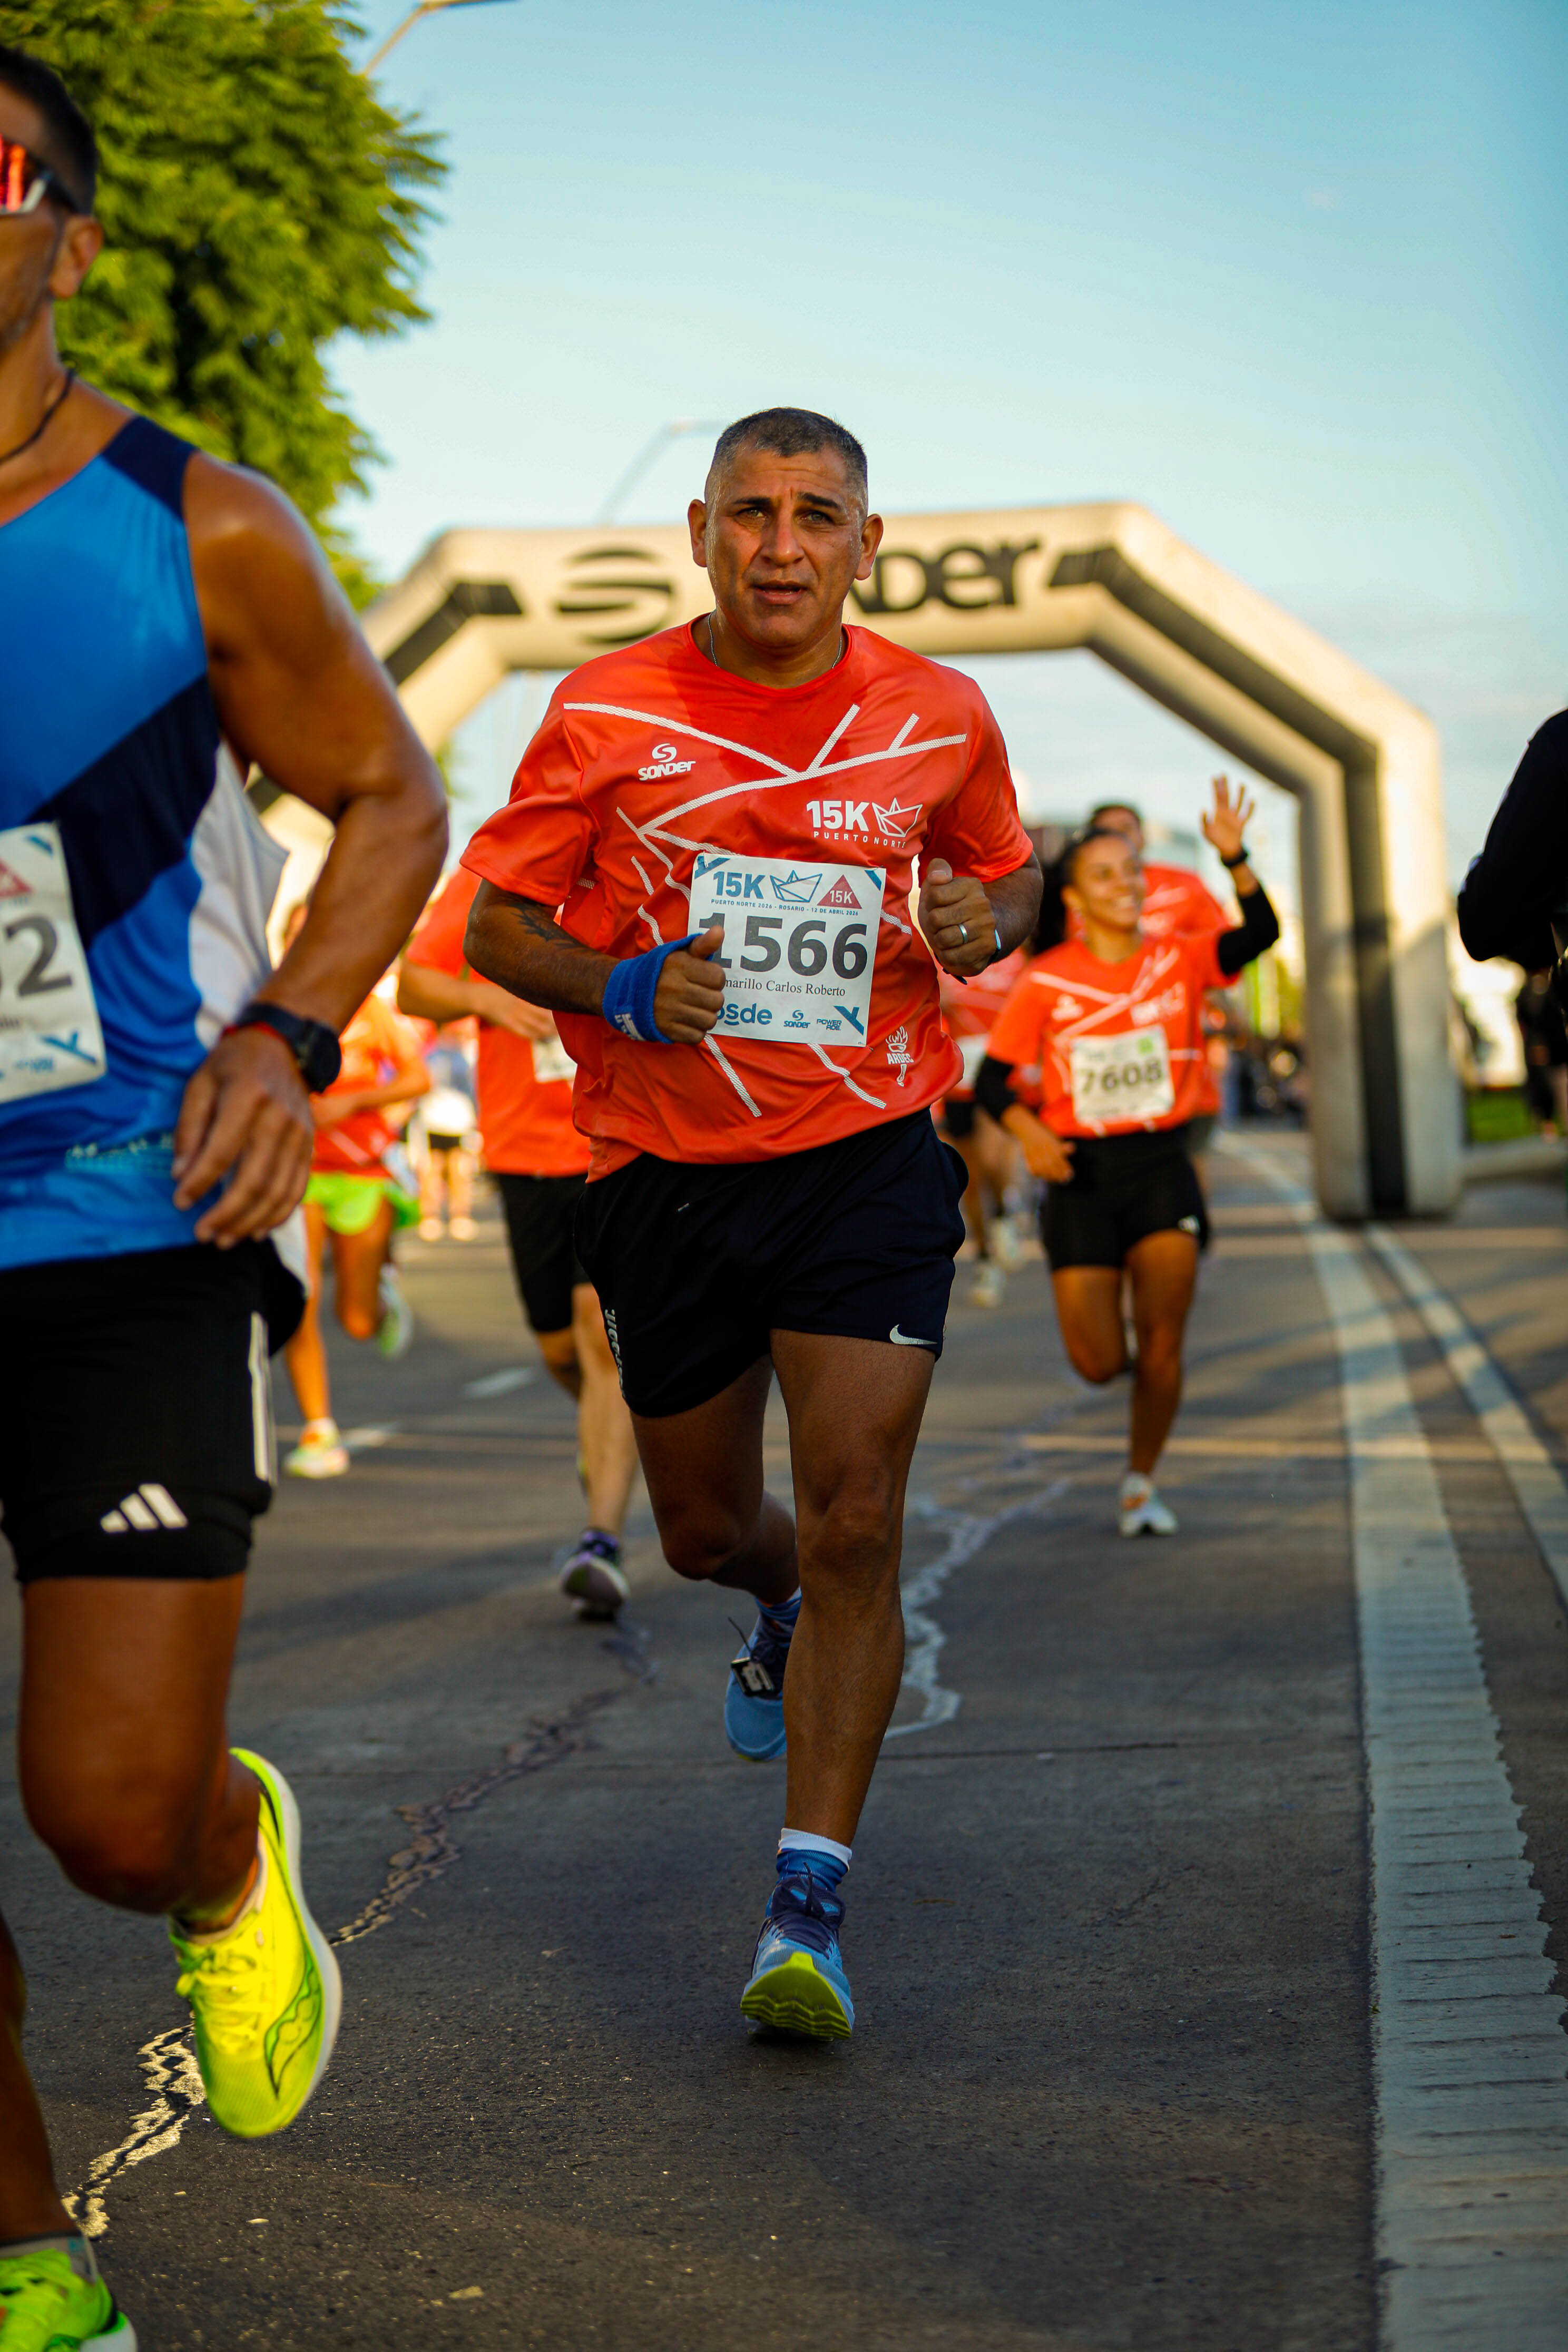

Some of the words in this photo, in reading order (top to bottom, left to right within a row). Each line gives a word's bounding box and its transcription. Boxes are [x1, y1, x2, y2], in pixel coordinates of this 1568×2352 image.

[806, 800, 870, 832] 15K
[814, 831, 868, 843] PUERTO
[874, 837, 906, 848] NORTE
[713, 871, 766, 899] 15K
[829, 889, 852, 904] 15K
[699, 912, 868, 979] 1566
[725, 978, 762, 990] marillo
[766, 981, 802, 993] Carlos
[806, 983, 846, 996] Roberto
[886, 1053, 914, 1065] ARDEC
